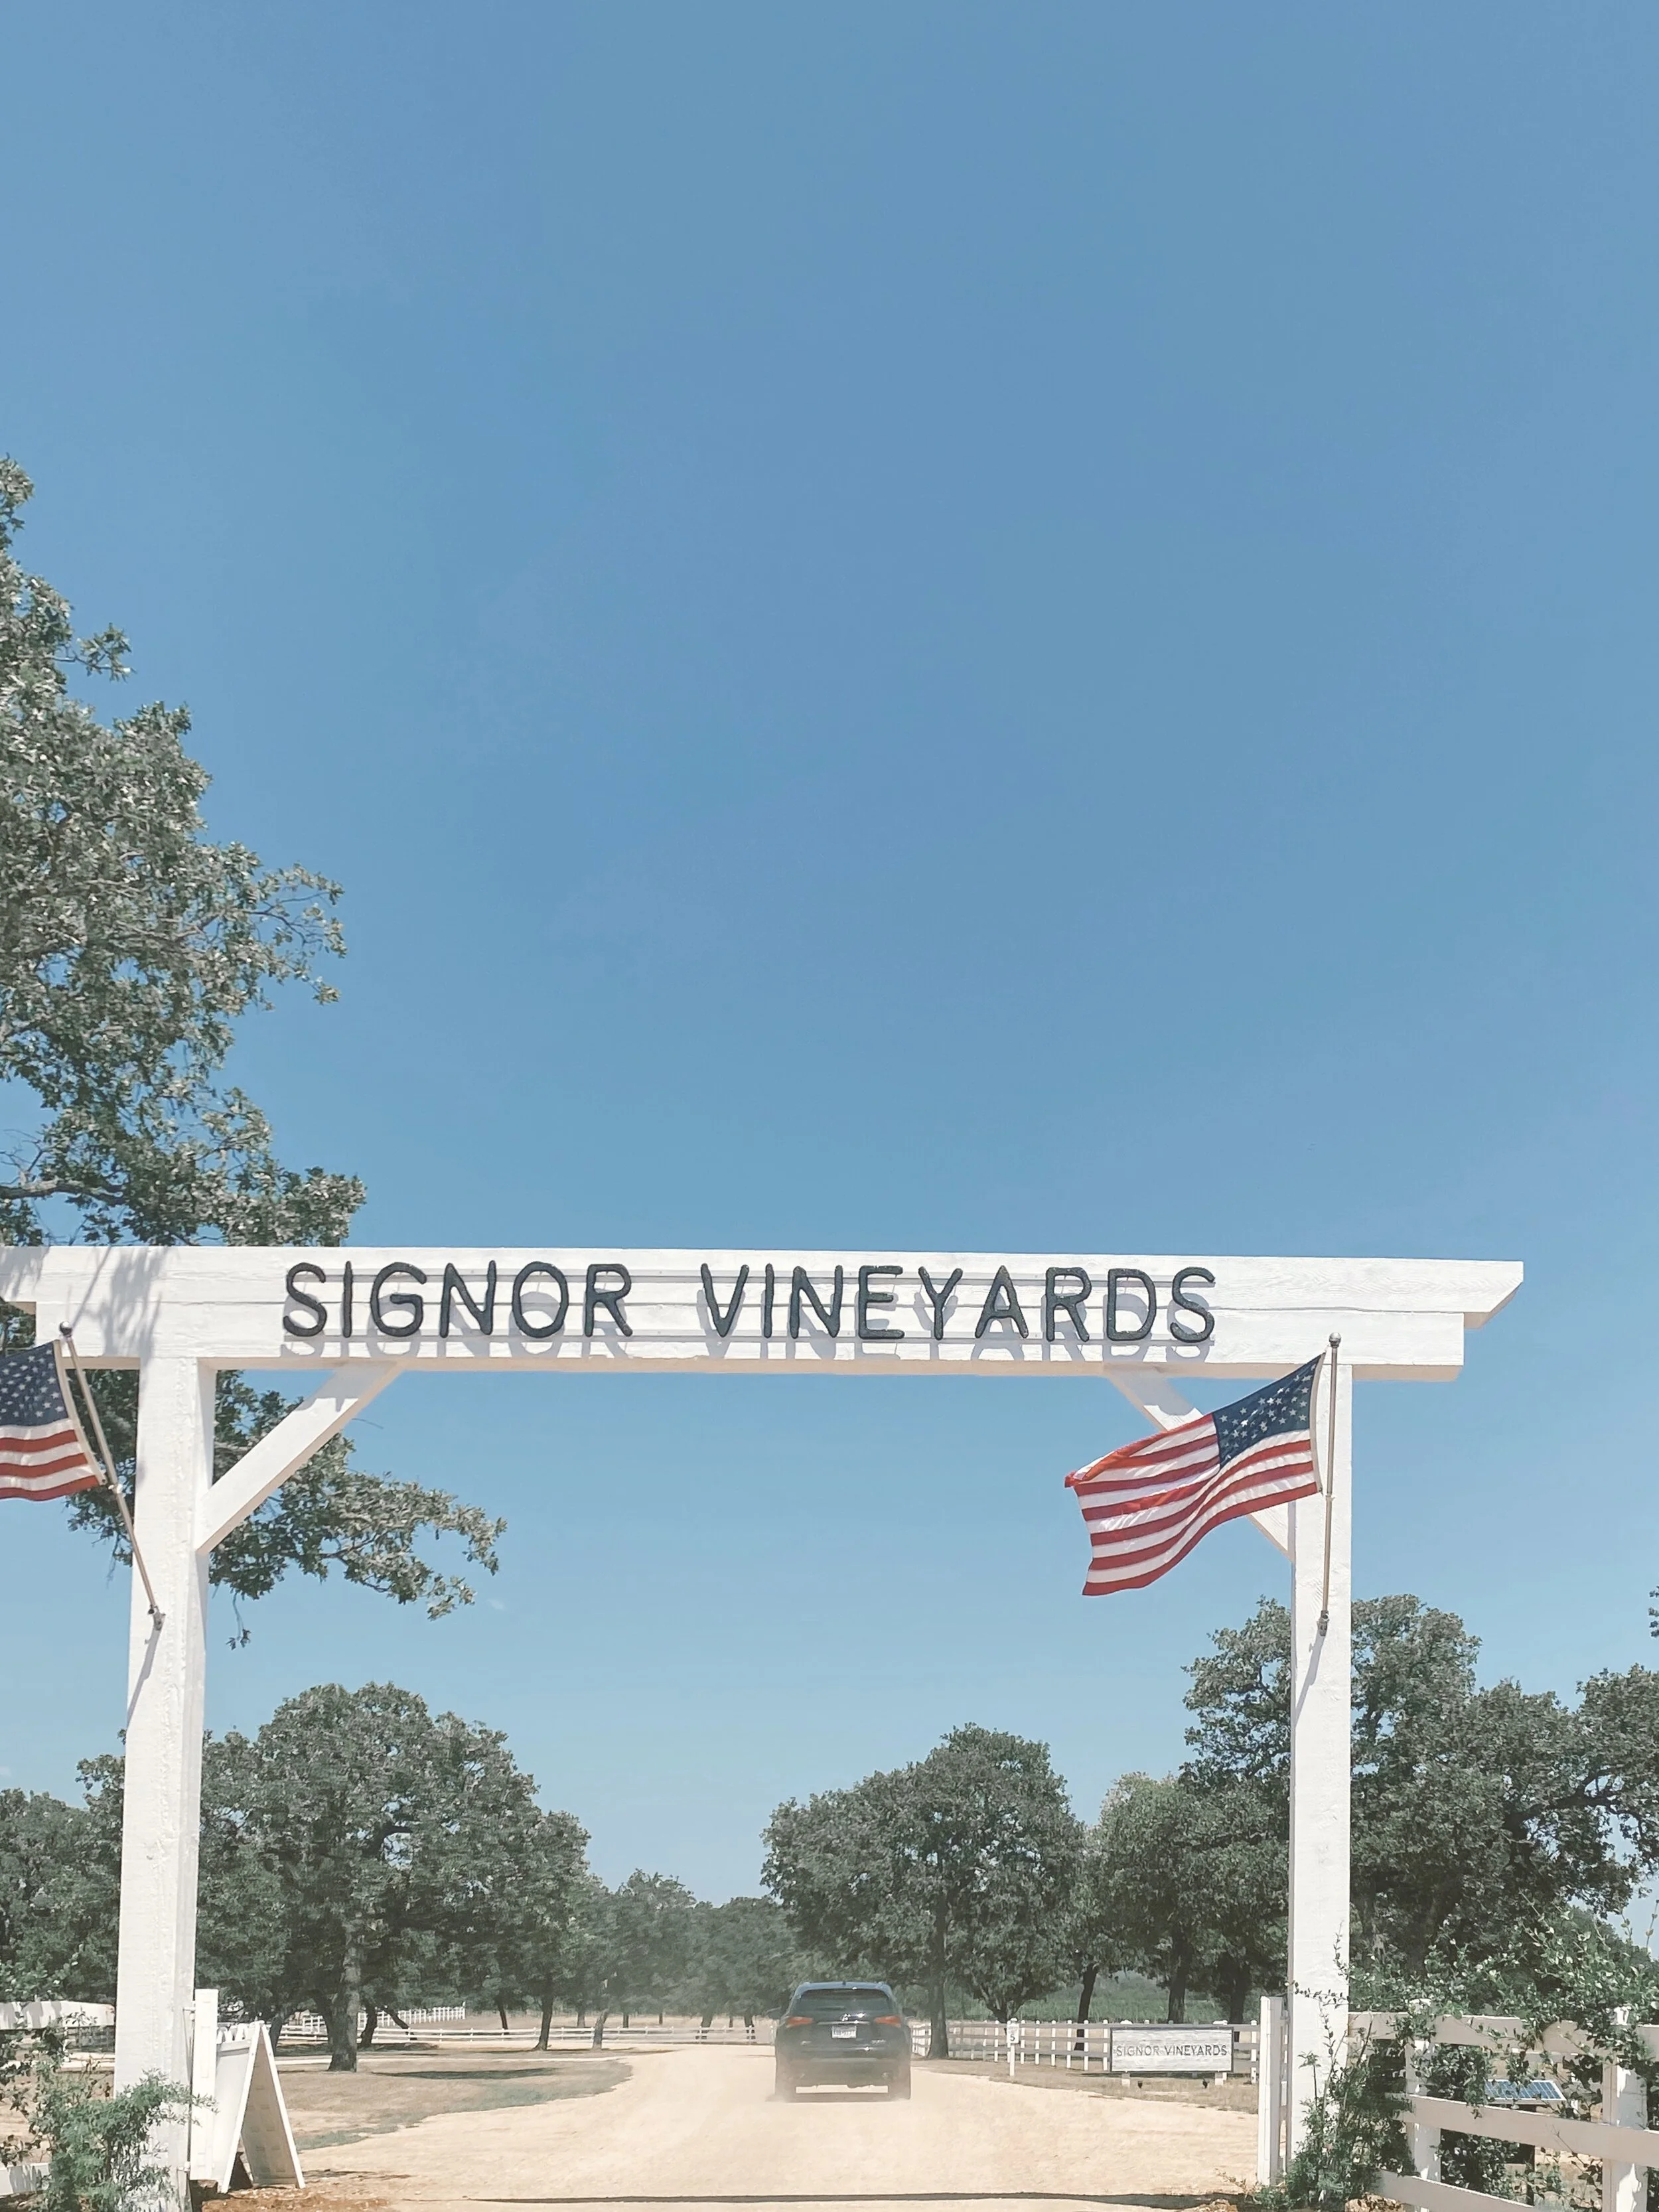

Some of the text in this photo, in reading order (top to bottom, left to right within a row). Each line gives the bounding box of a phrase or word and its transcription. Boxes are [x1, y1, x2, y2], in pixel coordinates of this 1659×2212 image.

[283, 1260, 1216, 1343] SIGNOR VINEYARDS
[1116, 2045, 1227, 2057] SIGNOR VINEYARDS
